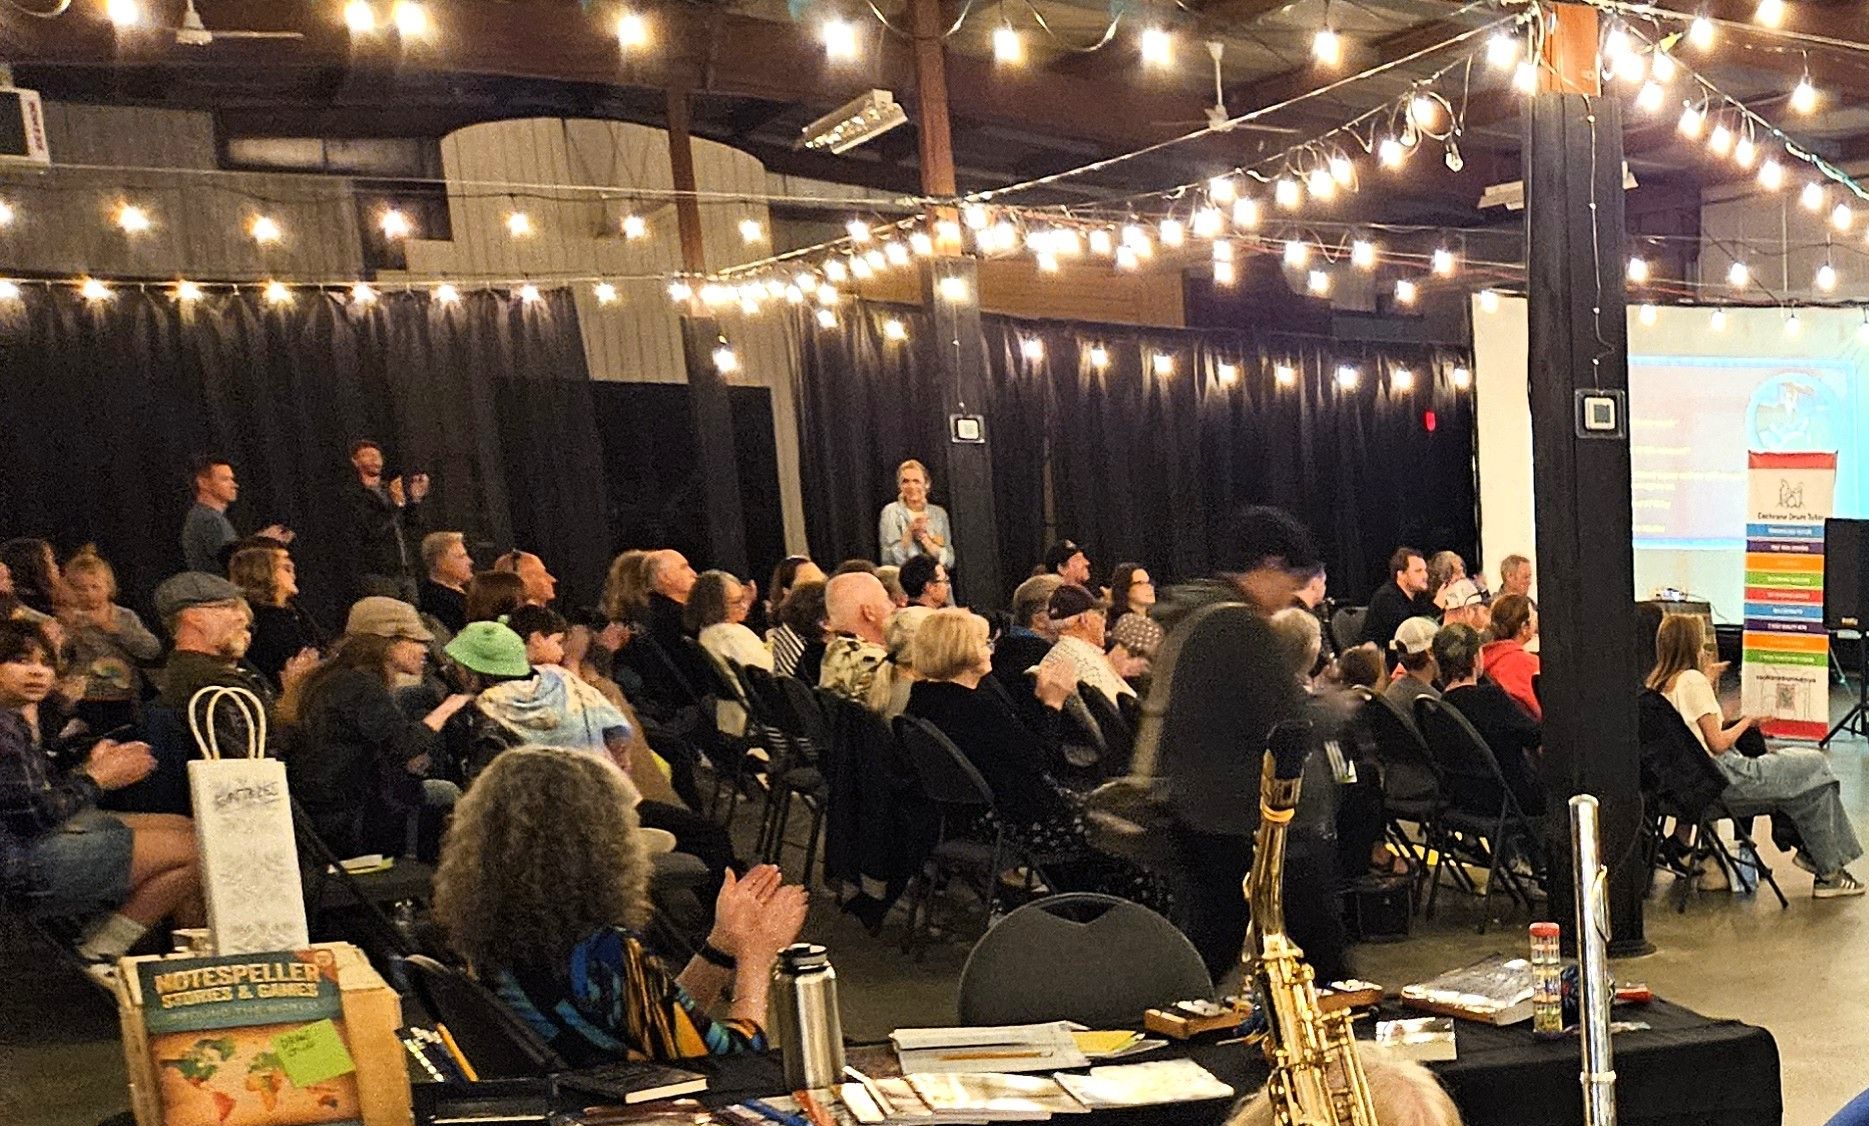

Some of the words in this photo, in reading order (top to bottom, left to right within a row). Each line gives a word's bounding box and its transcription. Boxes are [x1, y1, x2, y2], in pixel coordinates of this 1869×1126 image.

[154, 962, 322, 993] NOTESPELLER
[161, 986, 233, 1008] STORIES
[237, 984, 254, 999] &
[257, 982, 319, 999] GAMES
